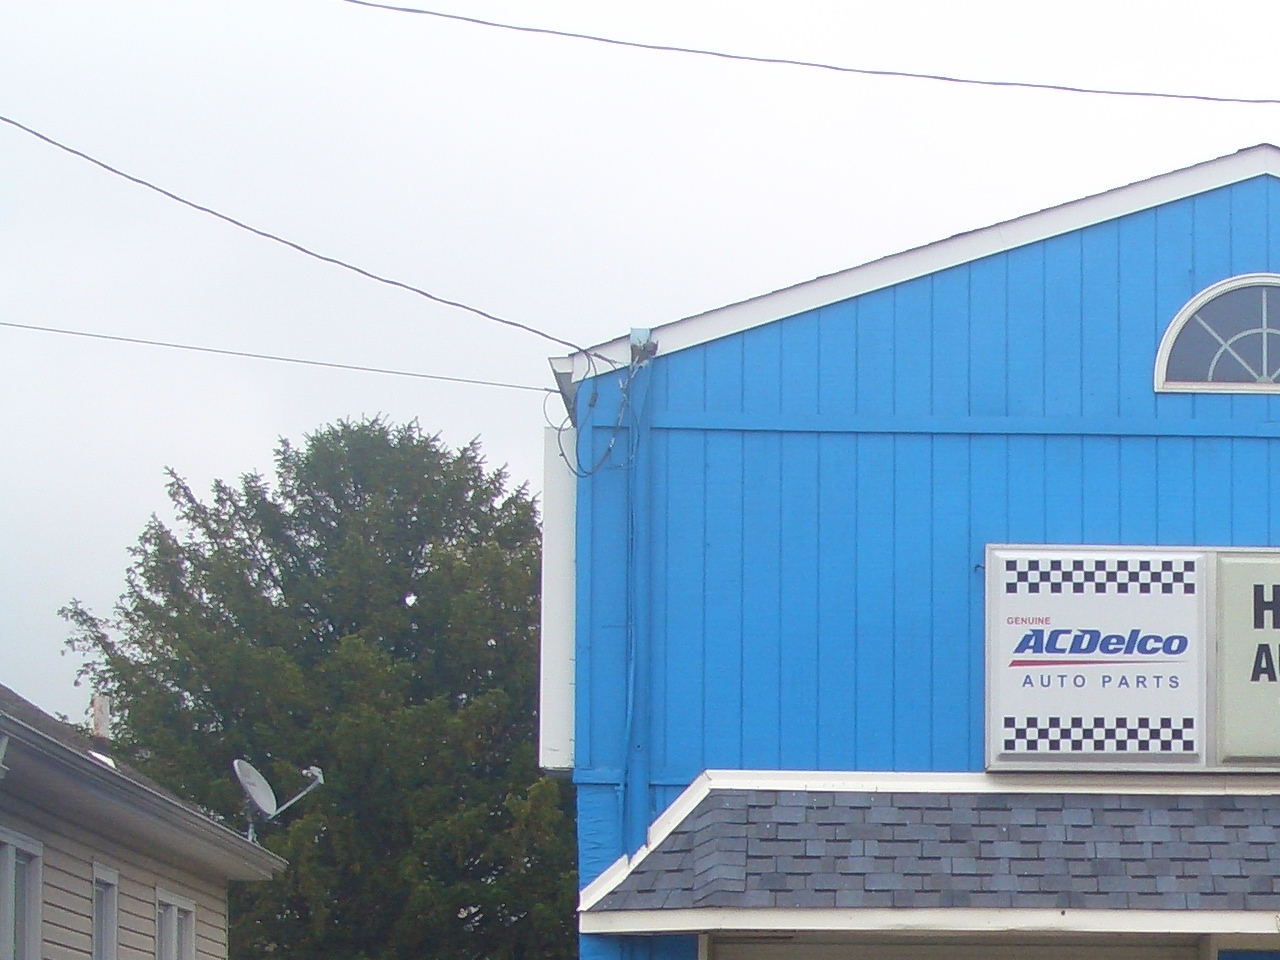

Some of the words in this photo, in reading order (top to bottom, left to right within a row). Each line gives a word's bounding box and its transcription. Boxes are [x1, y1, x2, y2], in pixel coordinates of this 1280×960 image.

[1006, 616, 1051, 625] GENUINE
[1012, 628, 1189, 656] ACDelco
[1021, 674, 1088, 689] AUTO
[1101, 674, 1181, 689] PARTS
